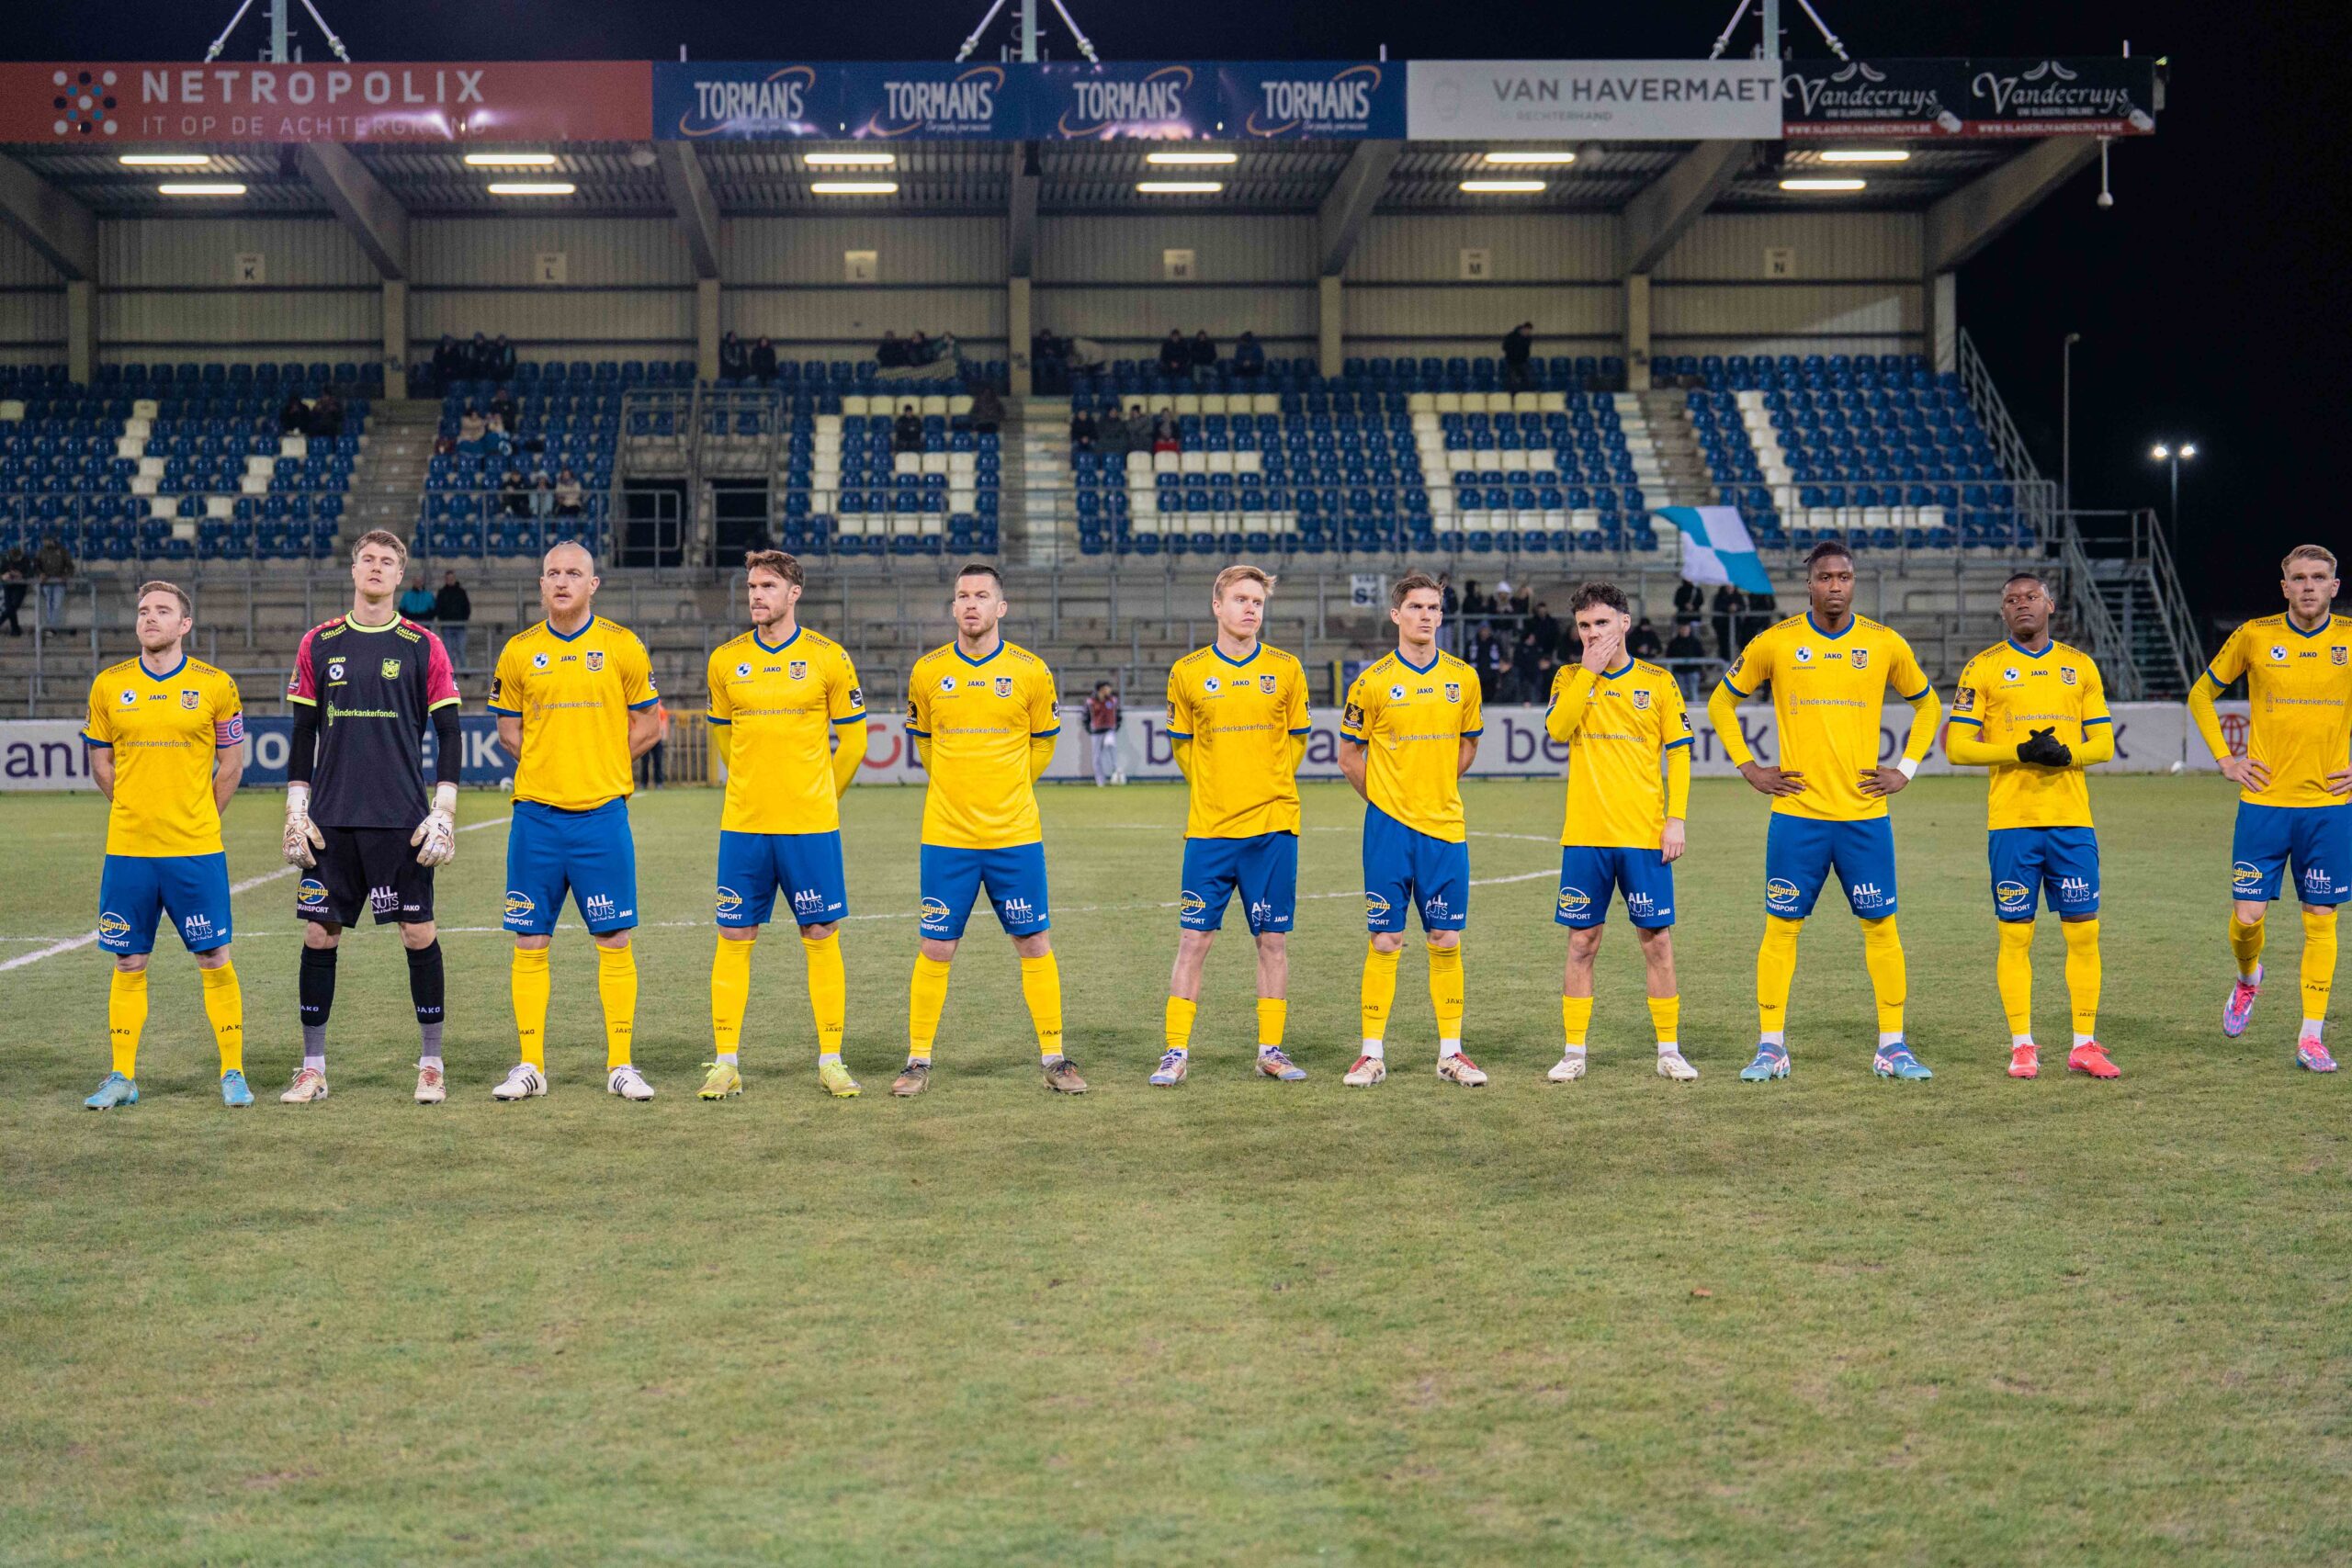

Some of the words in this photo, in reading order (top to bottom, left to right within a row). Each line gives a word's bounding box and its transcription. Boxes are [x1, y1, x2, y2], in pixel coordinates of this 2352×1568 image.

[141, 70, 485, 105] NETROPOLIX
[1492, 78, 1559, 102] VAN
[1571, 77, 1775, 102] HAVERMAET
[1972, 72, 2130, 116] Vandecruys
[694, 81, 804, 120] TORMANS
[883, 81, 994, 120] TORMANS
[1072, 81, 1182, 120] TORMANS
[1260, 81, 1371, 120] TORMANS
[1782, 73, 1939, 117] Vandecruys
[142, 116, 167, 136] IT
[181, 116, 217, 136] OP
[232, 116, 265, 136] DE
[1776, 617, 1802, 628] CALLANT
[1859, 618, 1886, 631] CALLANT
[321, 624, 346, 638] CALLANT
[396, 626, 422, 641] CALLANT
[805, 633, 831, 647] CALLANT
[327, 656, 346, 664] JAKO
[1009, 648, 1035, 662] CALLANT
[1182, 649, 1208, 663] CALLANT
[191, 662, 218, 675] CALLANT
[1603, 690, 1621, 698] JAKO
[1799, 698, 1867, 708] kinderkankerfonds
[2275, 697, 2344, 706] kinderkankerfonds
[334, 708, 396, 718] kinderkankerfonds
[227, 718, 243, 739] C
[2304, 867, 2331, 881] ALL.
[1852, 882, 1882, 897] ALL.
[2061, 876, 2089, 889] ALL.
[2304, 879, 2331, 890] NUTS
[370, 886, 398, 900] ALL.
[794, 888, 822, 903] ALL.
[2062, 887, 2090, 899] NUTS
[2334, 886, 2348, 894] JAKO
[370, 896, 400, 910] NUTS
[586, 894, 614, 908] ALL.
[795, 898, 824, 912] NUTS
[1005, 897, 1032, 911] ALL.
[1628, 892, 1654, 904] ALL.
[1853, 893, 1883, 906] NUTS
[587, 904, 616, 919] NUTS
[827, 902, 842, 911] JAKO
[1628, 902, 1655, 913] NUTS
[1657, 908, 1671, 916] JAKO
[185, 913, 211, 929] ALL.
[1006, 908, 1034, 920] NUTS
[1273, 915, 1289, 923] JAKO
[186, 925, 213, 939] NUTS
[2304, 983, 2330, 992] JAKO
